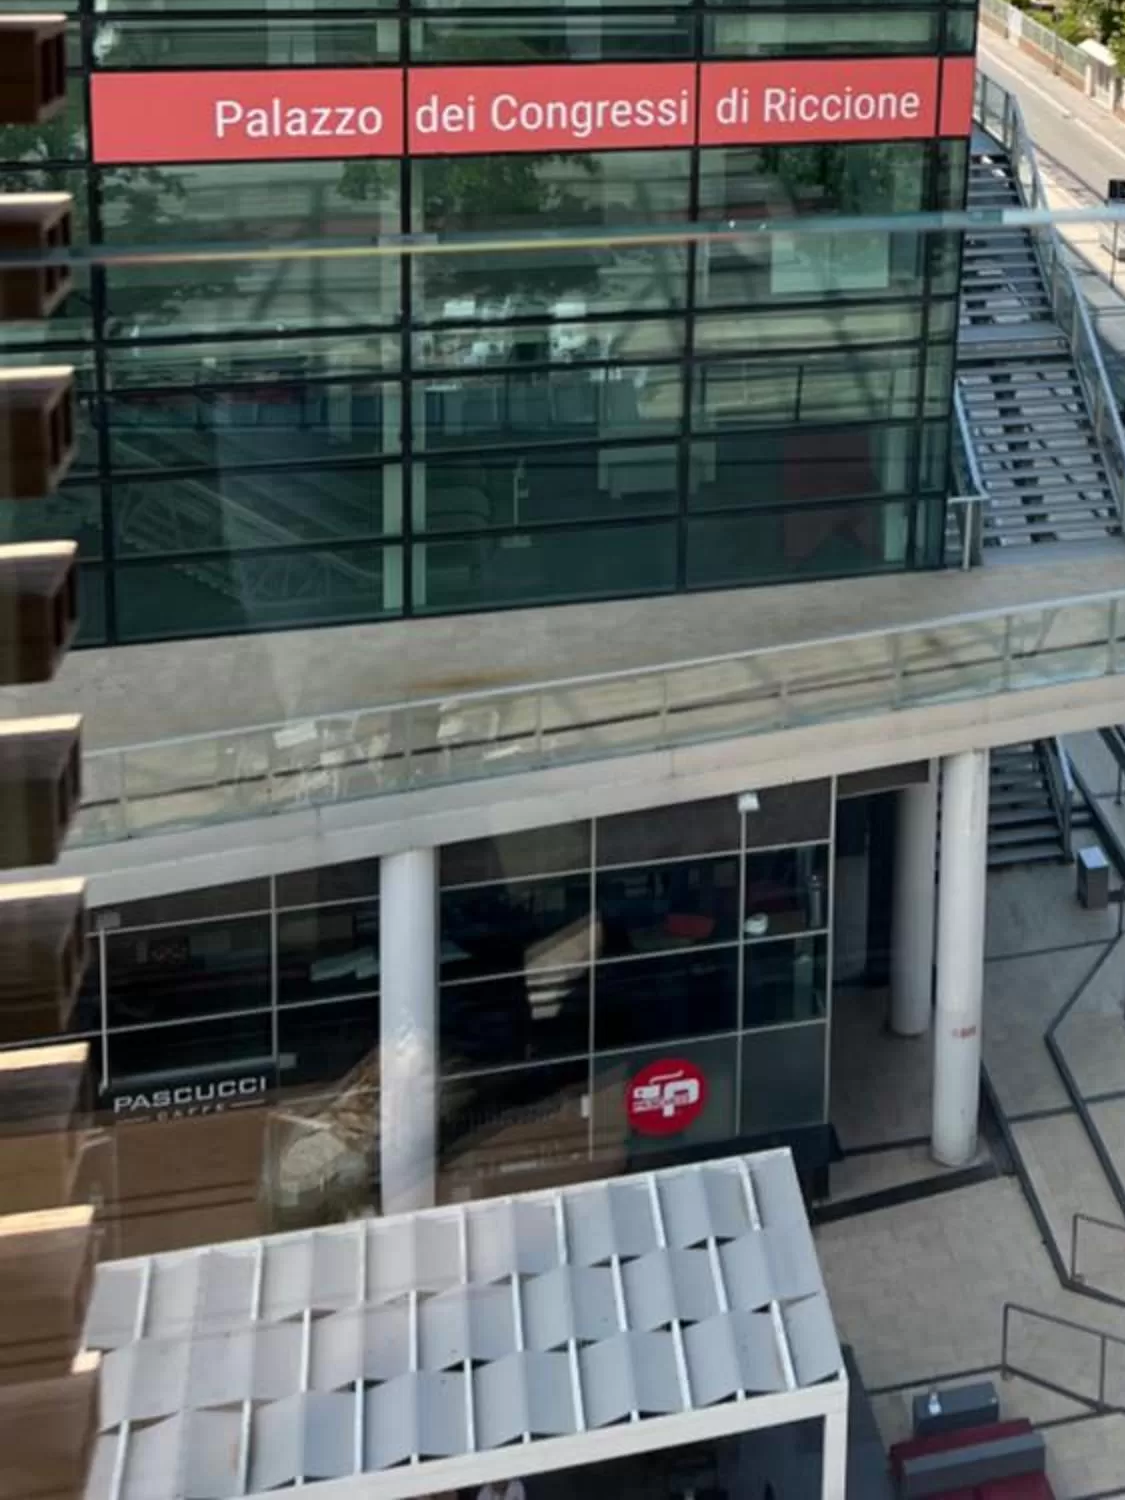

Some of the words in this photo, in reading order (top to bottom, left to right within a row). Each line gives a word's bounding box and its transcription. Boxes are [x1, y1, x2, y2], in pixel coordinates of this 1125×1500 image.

[215, 100, 384, 139] Palazzo
[415, 94, 476, 134] dei
[491, 89, 689, 138] Congressi
[716, 88, 750, 125] di
[763, 87, 921, 123] Riccione
[113, 1076, 267, 1113] PASCUCCI
